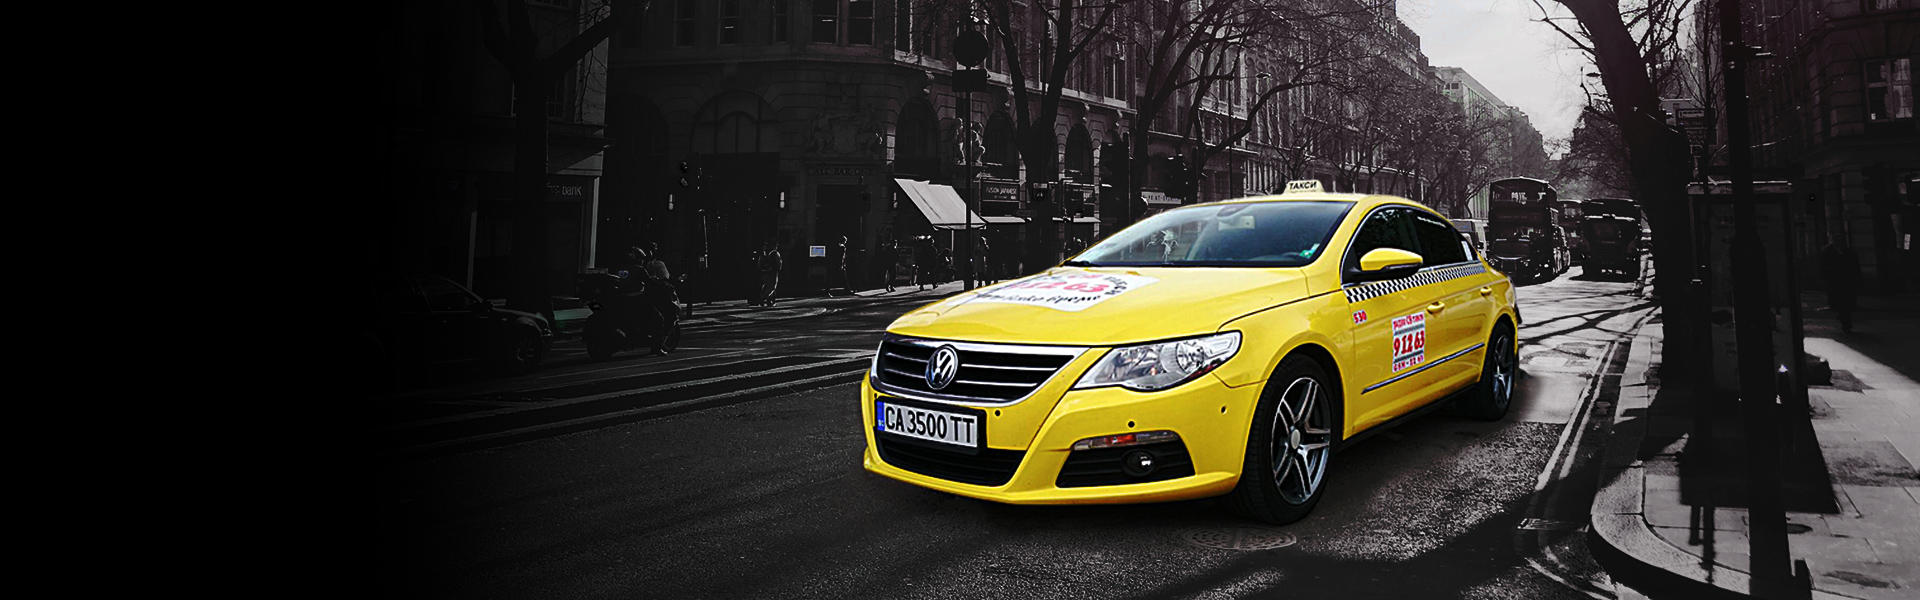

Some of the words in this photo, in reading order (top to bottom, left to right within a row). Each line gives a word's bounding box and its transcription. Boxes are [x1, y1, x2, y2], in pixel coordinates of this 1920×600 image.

[1289, 181, 1317, 190] ТАКСИ
[885, 406, 904, 432] CA
[907, 410, 947, 439] 3500
[950, 415, 974, 443] TT
